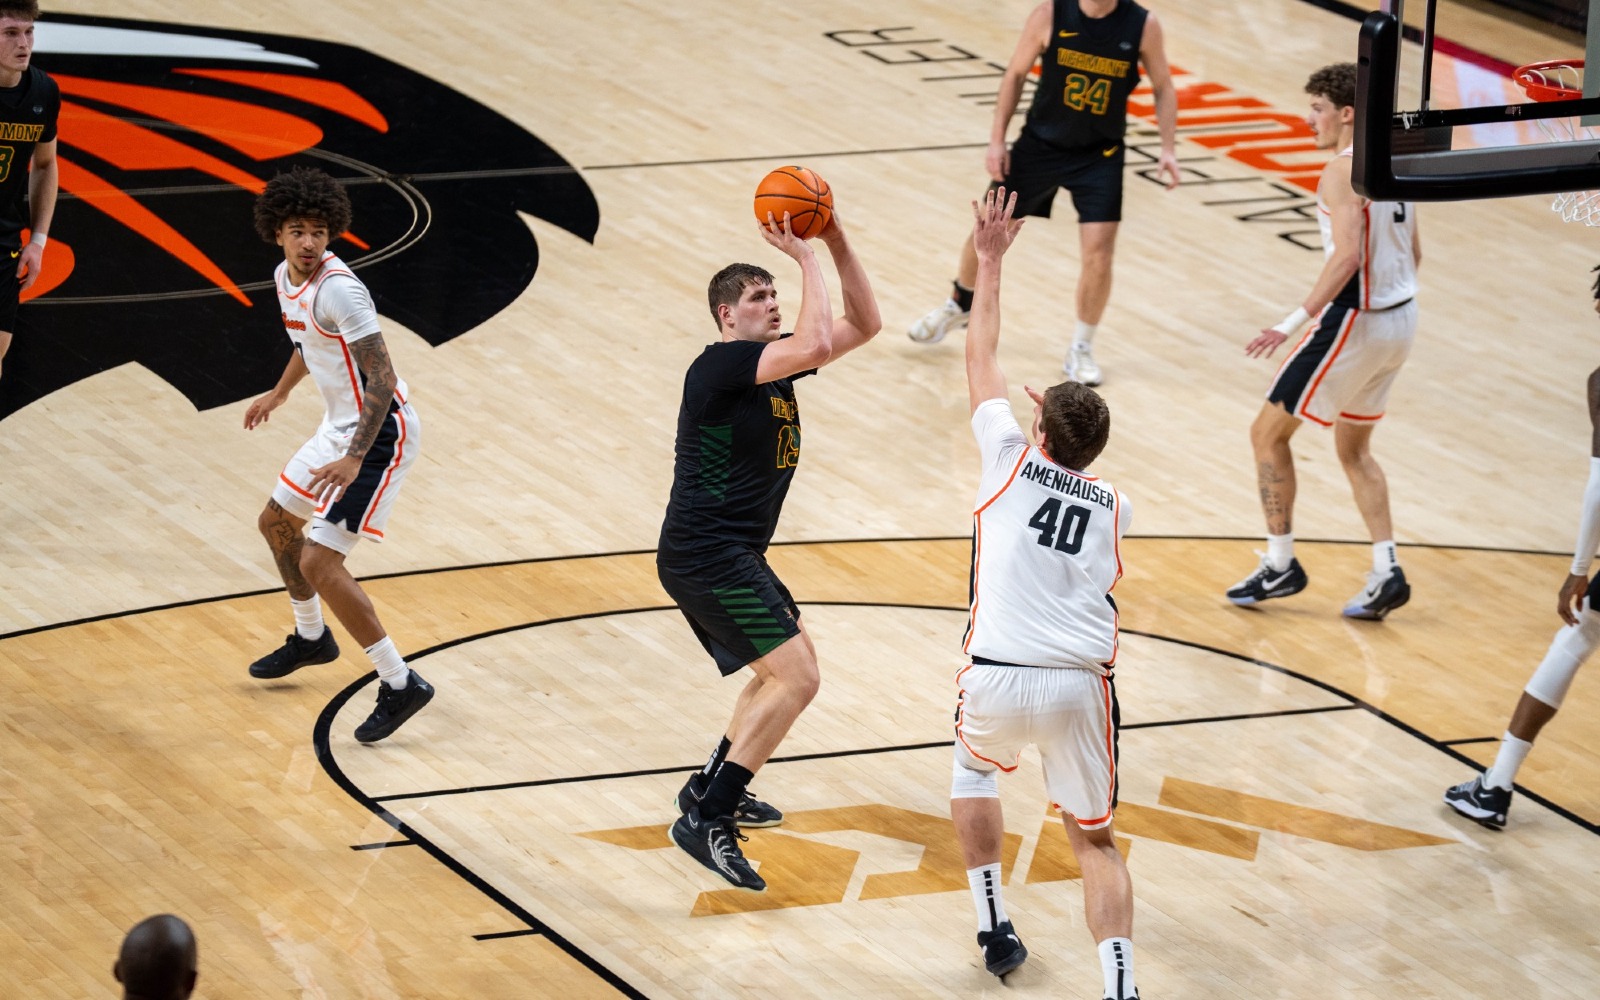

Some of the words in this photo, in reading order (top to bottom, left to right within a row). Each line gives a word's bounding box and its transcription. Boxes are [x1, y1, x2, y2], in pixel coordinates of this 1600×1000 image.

[1057, 47, 1131, 78] VERMONT
[1063, 73, 1112, 115] 24
[0, 122, 45, 142] MONT
[1020, 461, 1115, 511] AMENHAUSER
[1028, 497, 1092, 556] 40
